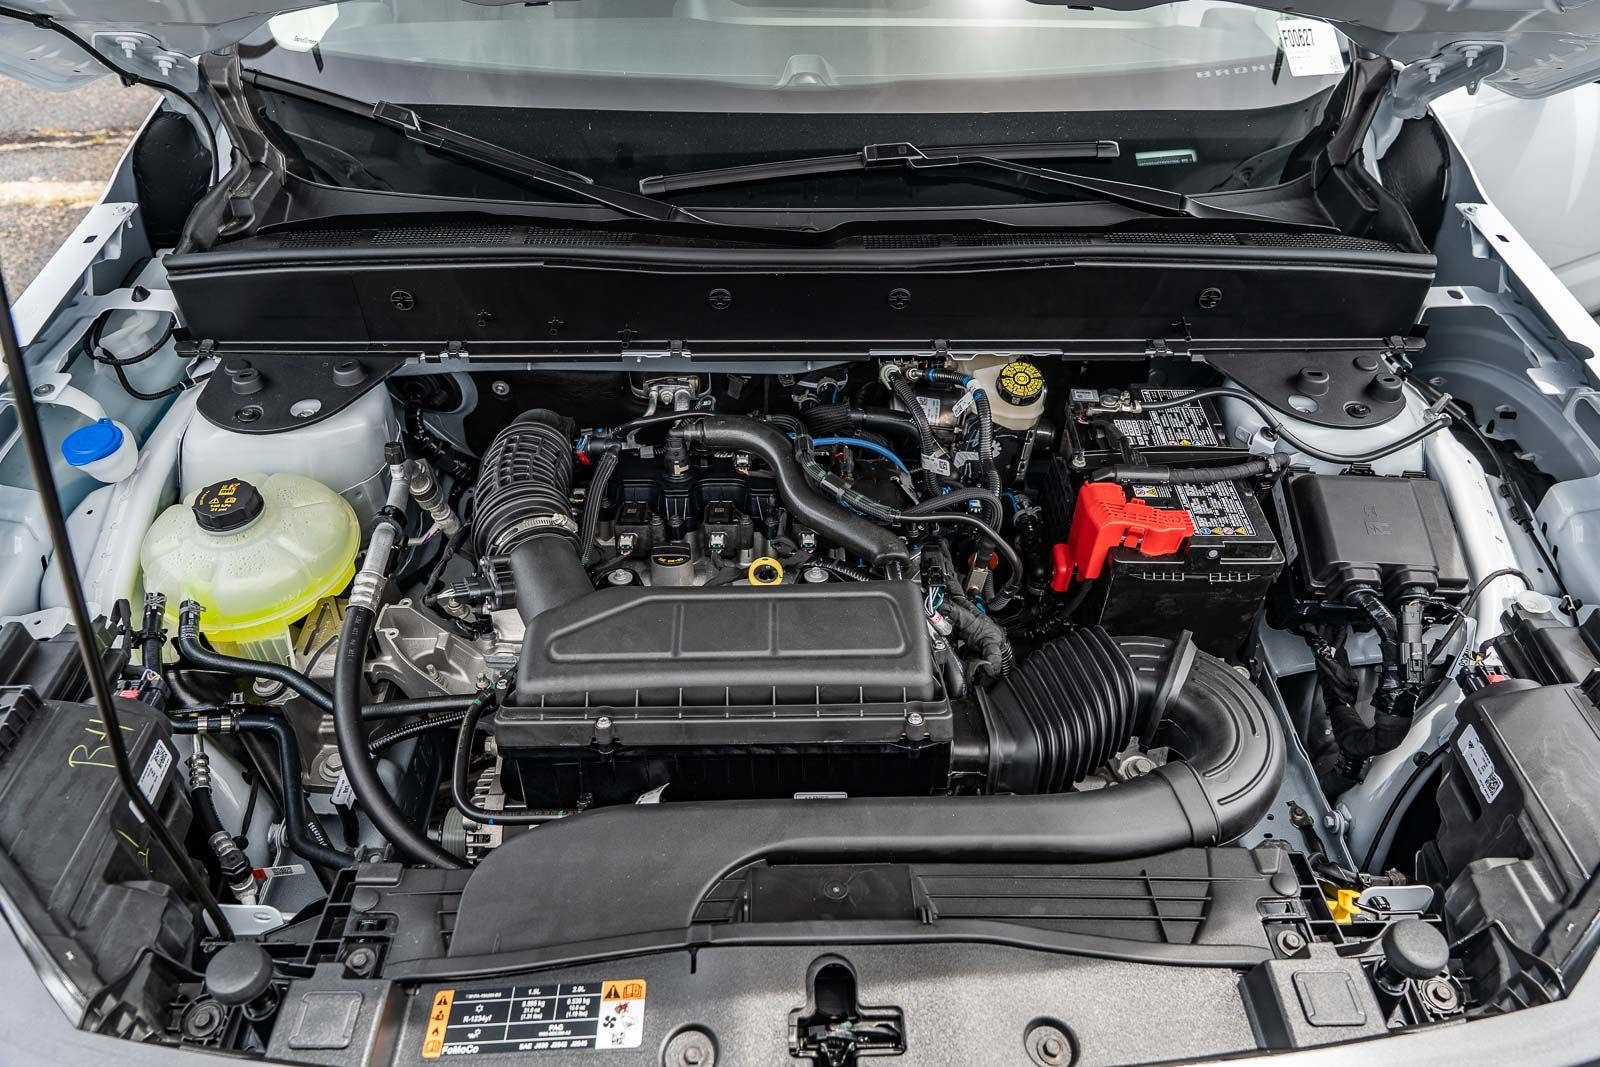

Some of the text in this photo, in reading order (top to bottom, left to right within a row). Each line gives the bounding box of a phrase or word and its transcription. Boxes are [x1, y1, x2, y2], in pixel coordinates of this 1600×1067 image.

[1281, 28, 1314, 48] F00627
[538, 1000, 546, 1008] kg
[583, 998, 591, 1006] kg
[462, 1014, 493, 1023] R-1234yf
[441, 1044, 480, 1056] FoMoCo
